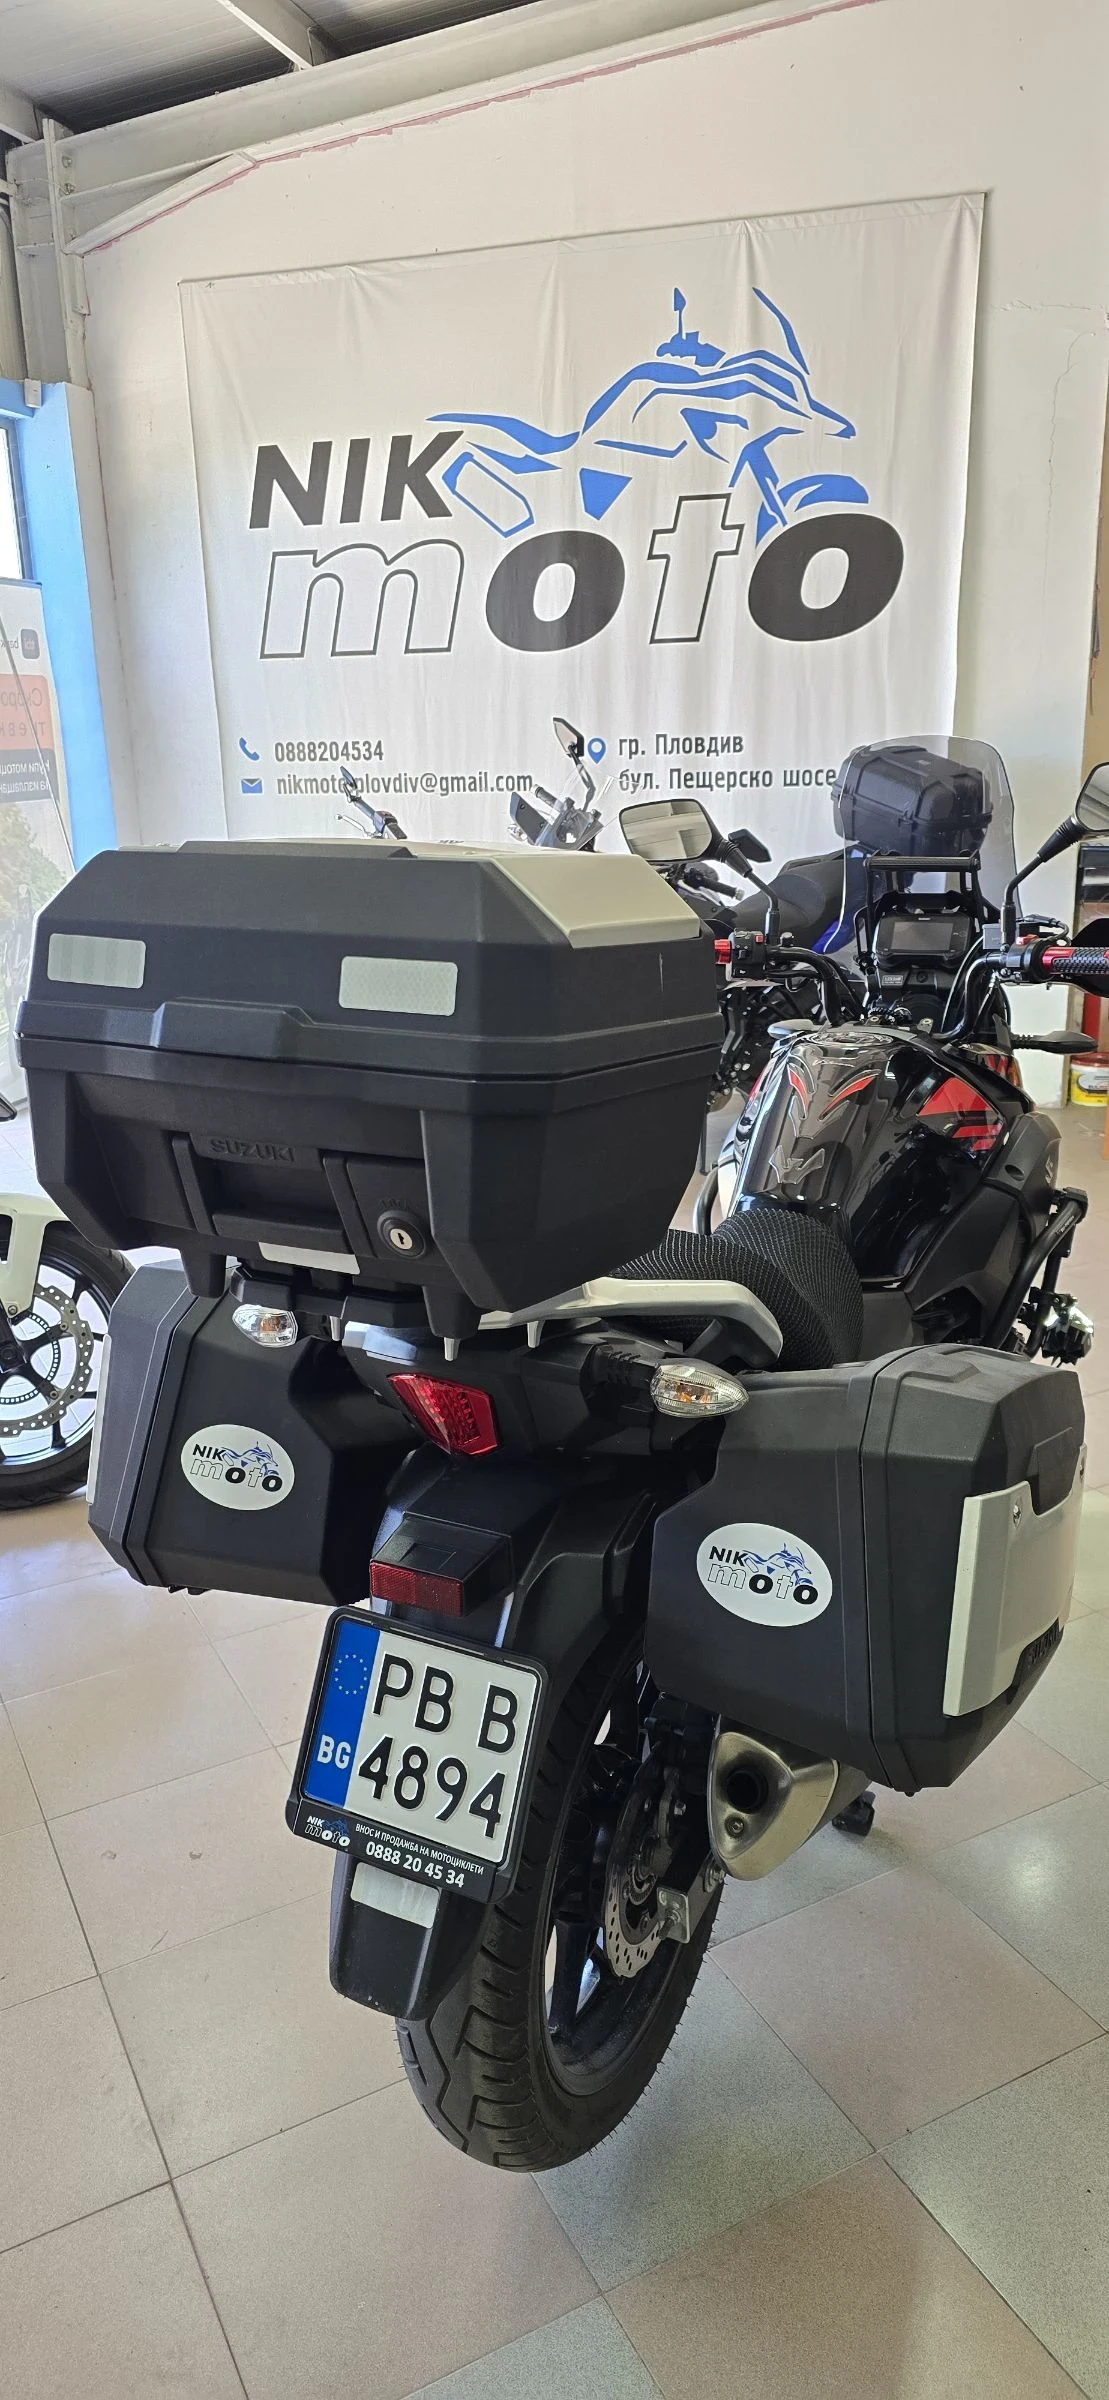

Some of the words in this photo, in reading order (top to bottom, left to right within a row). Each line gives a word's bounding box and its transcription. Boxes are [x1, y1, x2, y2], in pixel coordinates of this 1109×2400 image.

[249, 430, 464, 529] NIK
[260, 493, 905, 660] moto
[274, 740, 384, 762] 0888204534
[619, 738, 646, 760] гр.
[655, 733, 744, 757] Пловдив
[619, 769, 660, 794] бул.
[669, 768, 773, 792] Пещерско
[783, 767, 837, 787] шосе
[209, 1138, 296, 1162] SUZUKI
[192, 1444, 226, 1461] NIK
[190, 1459, 283, 1492] moto
[709, 1546, 748, 1567] NIK
[707, 1564, 819, 1605] moto
[373, 1653, 454, 1733] PB
[477, 1684, 518, 1754] B
[316, 1734, 351, 1769] BG
[358, 1736, 506, 1838] 4894
[304, 1823, 350, 1847] moto
[306, 1815, 325, 1827] NIK
[356, 1823, 375, 1838] ВНОС
[375, 1829, 380, 1839] И
[380, 1832, 419, 1853] ПРОДАЖБА
[419, 1845, 430, 1857] НА
[430, 1849, 485, 1875] МОТОЦИКЛЕТИ
[365, 1841, 400, 1865] 0888
[403, 1854, 422, 1872] 20
[424, 1862, 443, 1880] 45
[445, 1870, 465, 1888] 34
